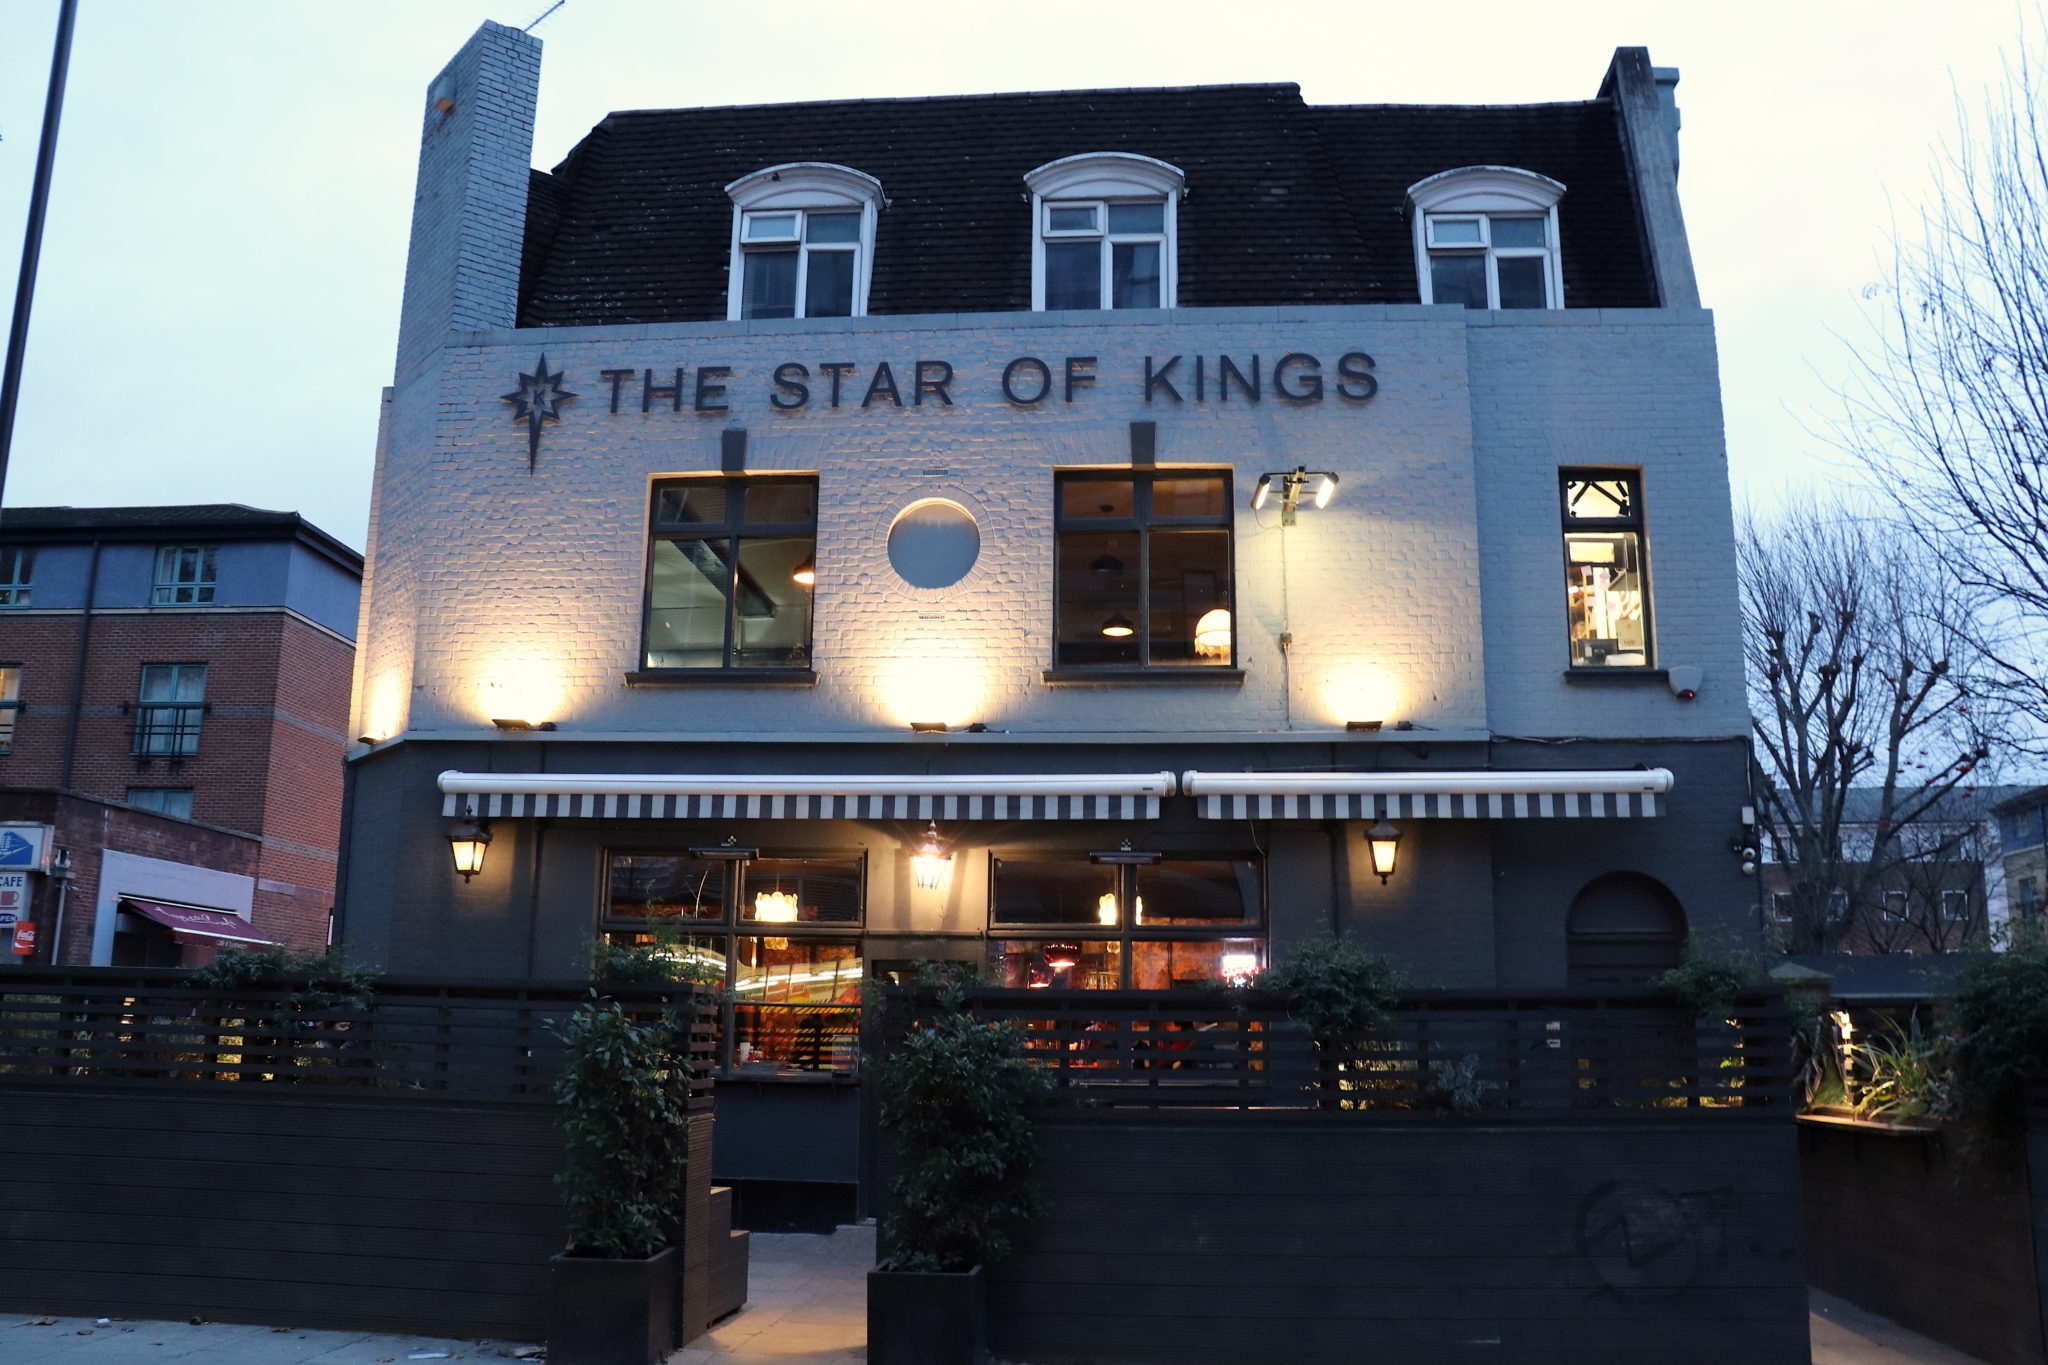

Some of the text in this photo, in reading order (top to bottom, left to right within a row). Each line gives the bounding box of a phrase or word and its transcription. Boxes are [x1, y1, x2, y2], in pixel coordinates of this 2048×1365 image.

[601, 352, 1379, 414] THE STAR OF KINGS
